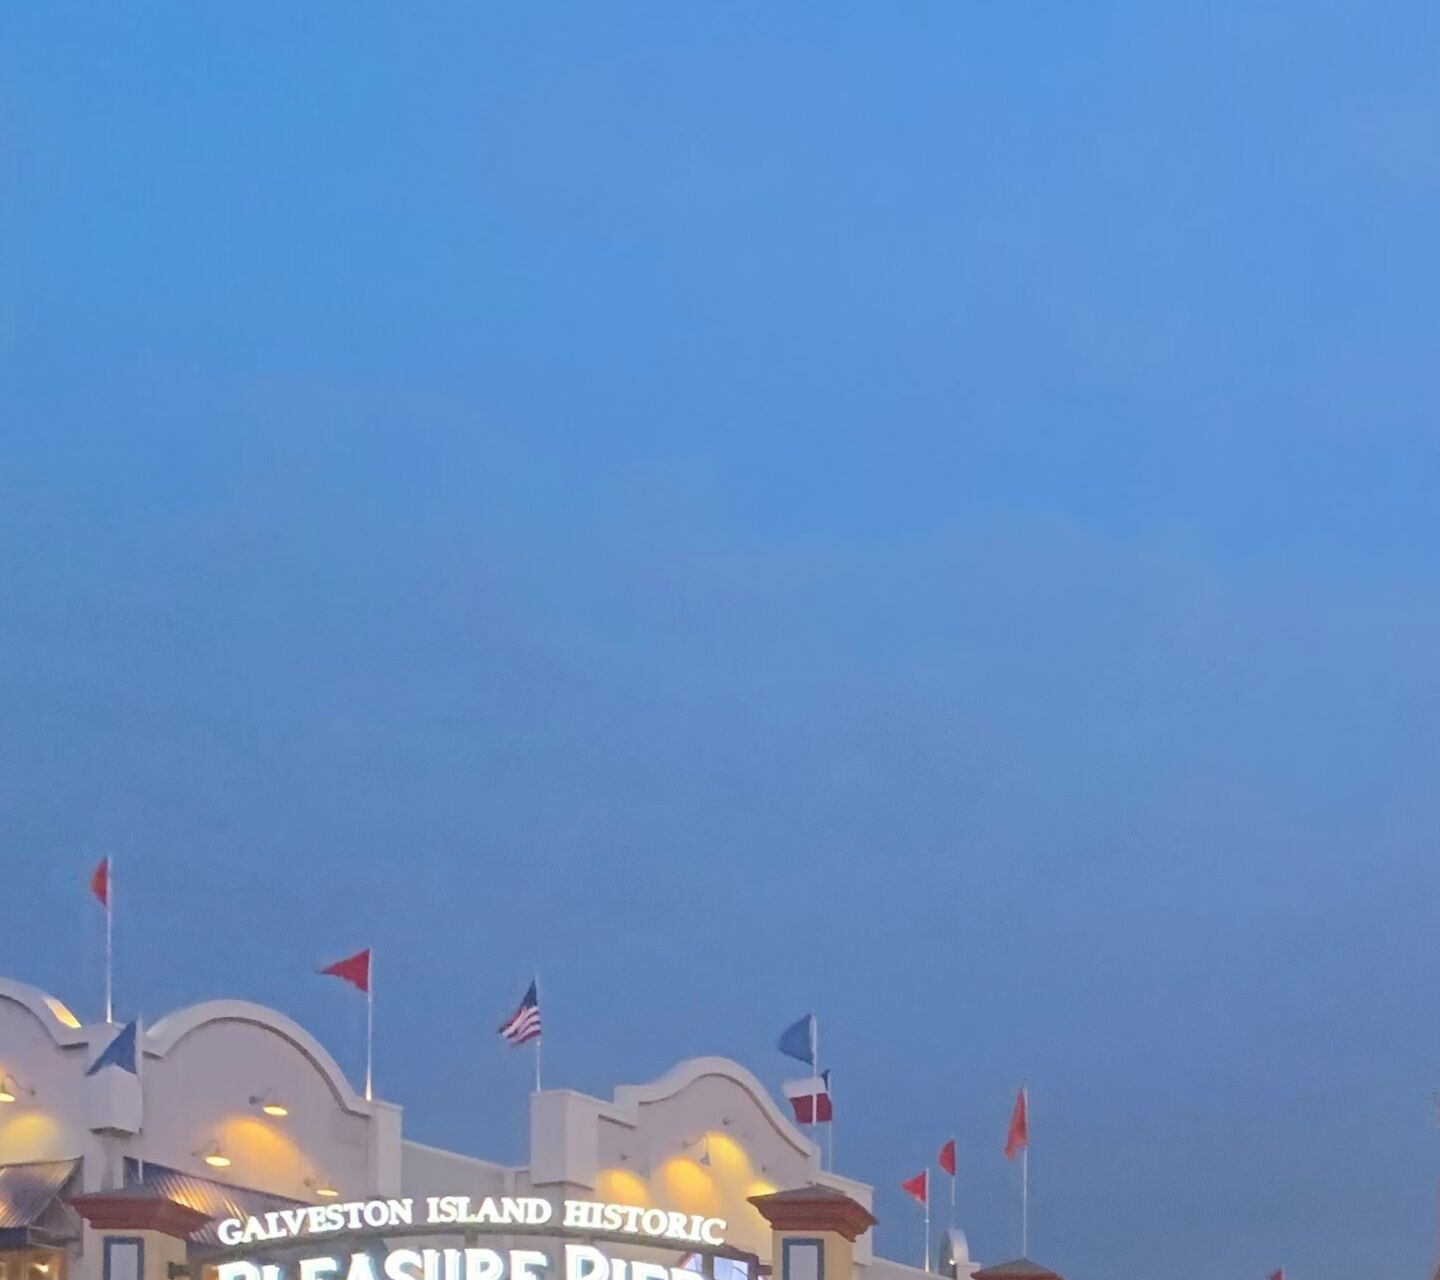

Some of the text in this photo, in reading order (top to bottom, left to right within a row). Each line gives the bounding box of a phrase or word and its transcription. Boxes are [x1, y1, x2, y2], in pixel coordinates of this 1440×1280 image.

[218, 1196, 727, 1246] GALVESTON ISLAND HISTORIC
